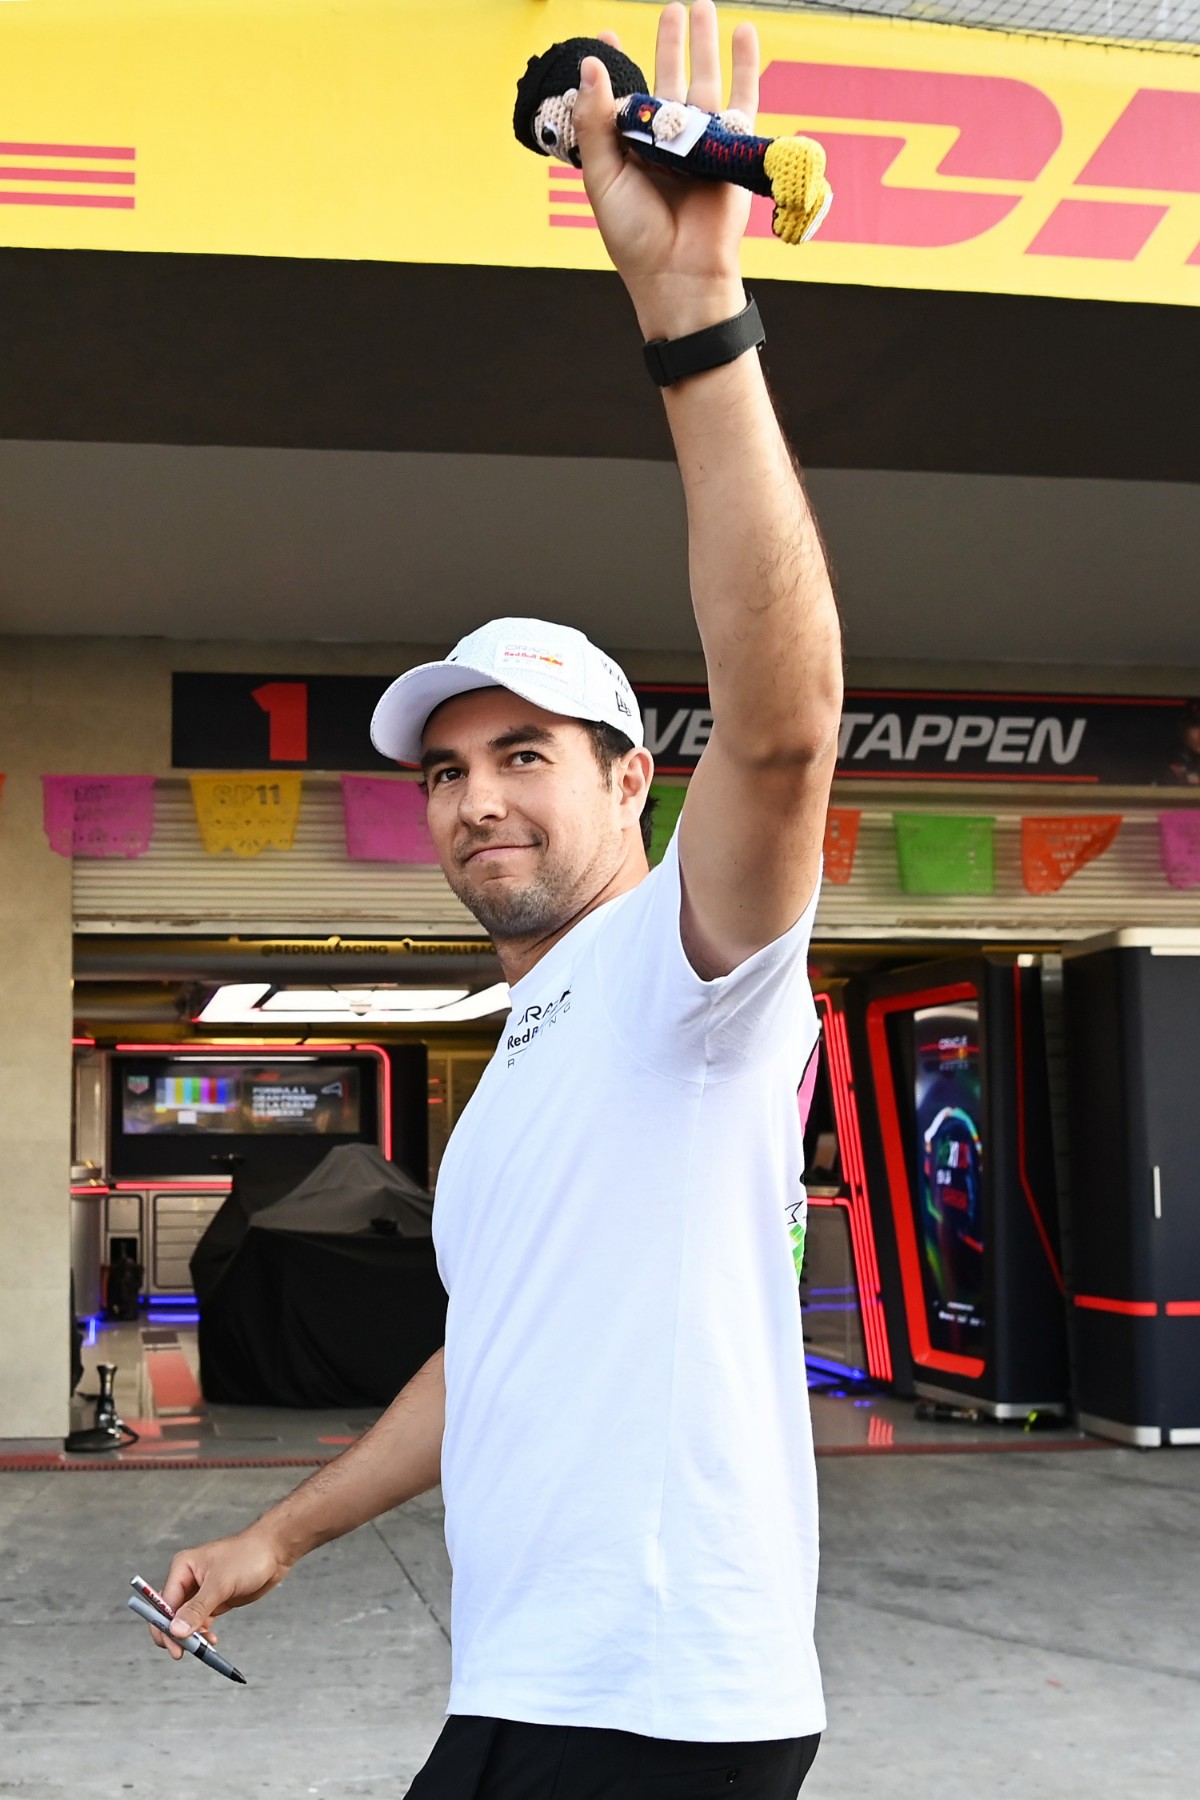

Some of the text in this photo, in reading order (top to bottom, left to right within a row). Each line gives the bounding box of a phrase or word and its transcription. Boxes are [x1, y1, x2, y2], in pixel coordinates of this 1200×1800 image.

[250, 682, 1086, 765] 1 VETAPPEN
[507, 1028, 530, 1050] Red
